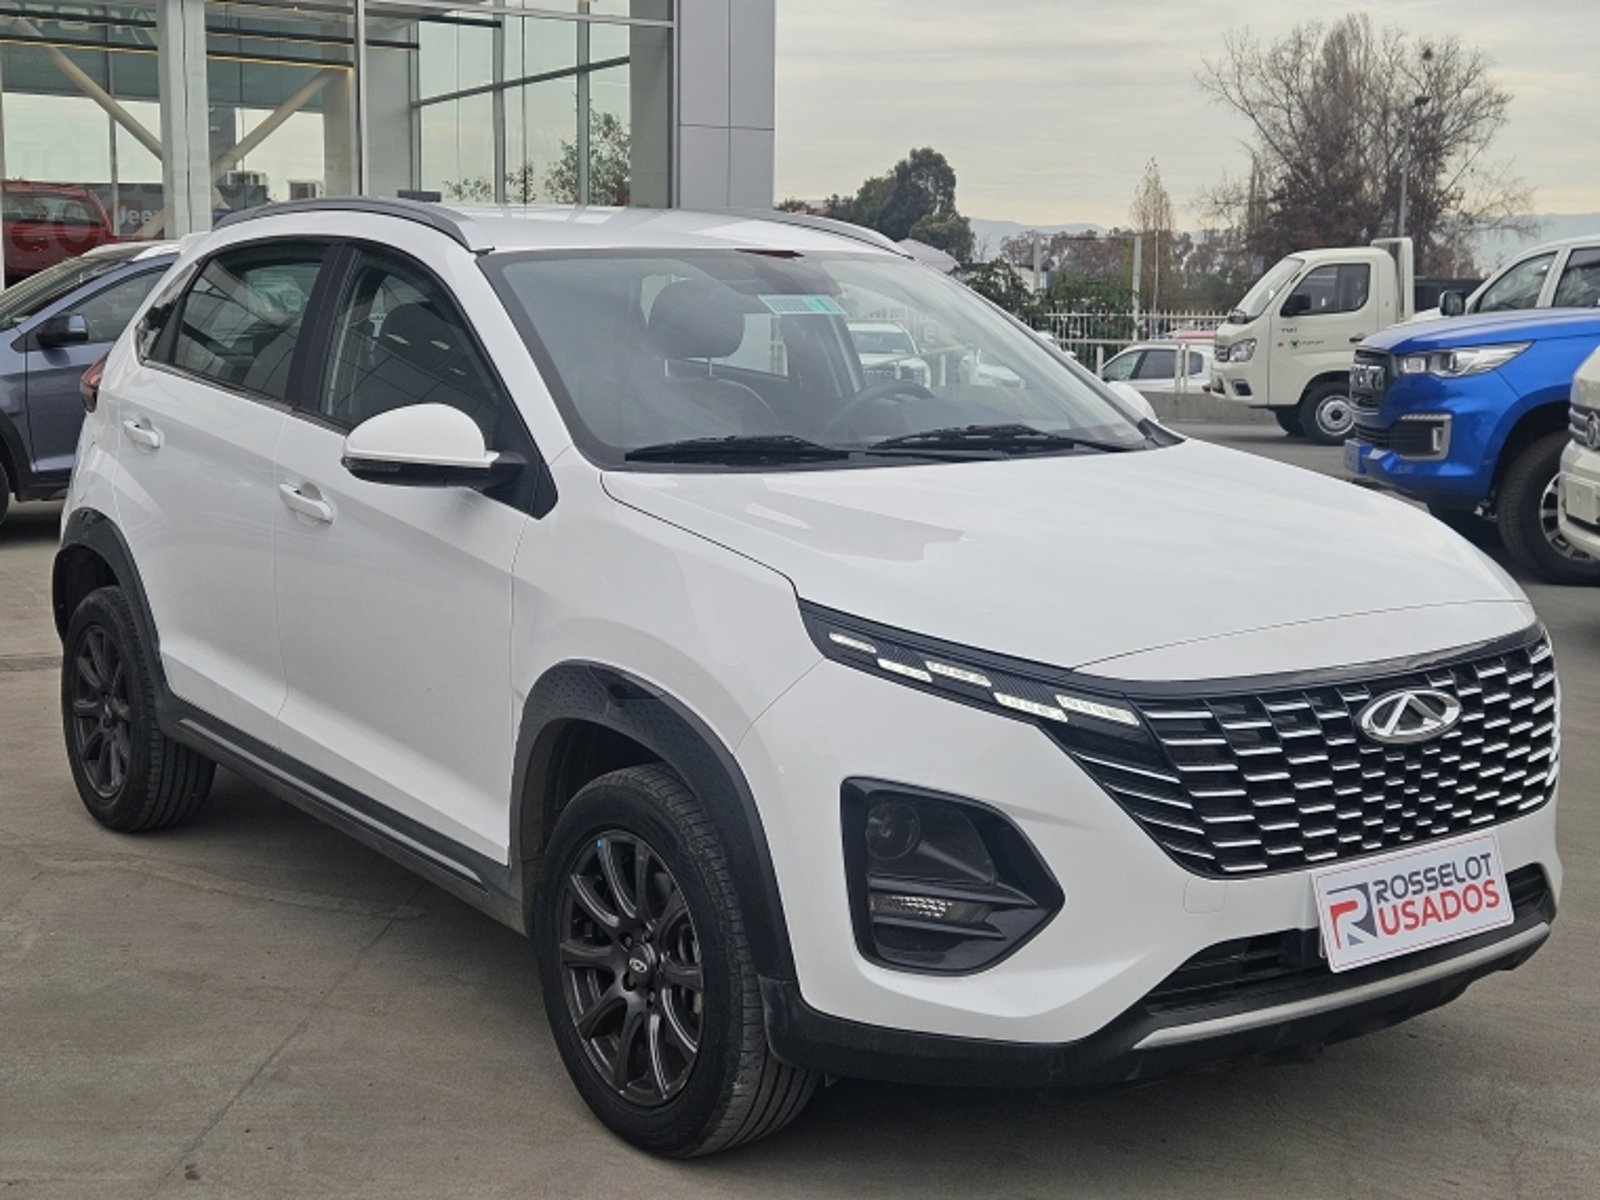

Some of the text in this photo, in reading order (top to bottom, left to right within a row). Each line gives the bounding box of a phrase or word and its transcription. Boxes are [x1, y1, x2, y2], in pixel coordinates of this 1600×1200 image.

[119, 205, 158, 225] Jee
[1373, 853, 1491, 904] ROSSELOT
[1379, 879, 1500, 935] USADOS
